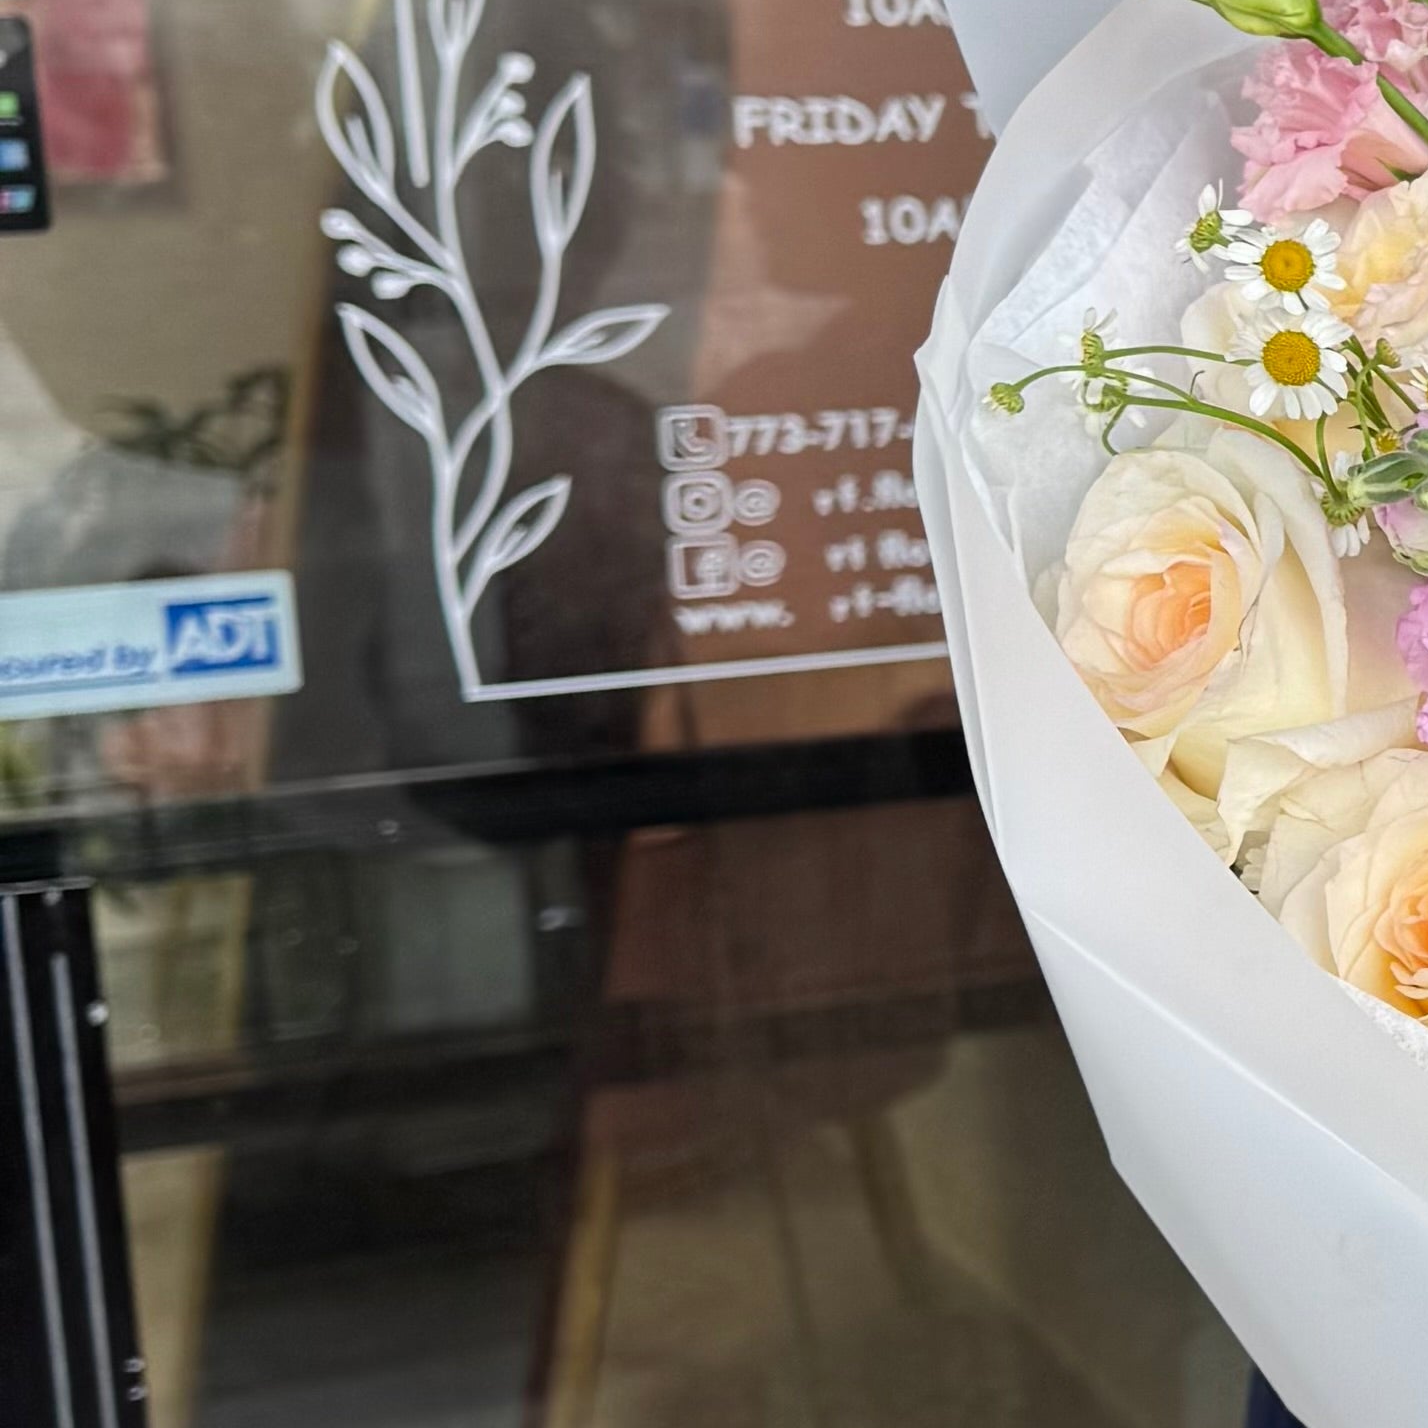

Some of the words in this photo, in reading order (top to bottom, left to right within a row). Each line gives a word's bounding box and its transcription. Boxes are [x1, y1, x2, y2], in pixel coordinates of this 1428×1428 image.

[732, 93, 946, 149] FRIDAY
[860, 193, 974, 246] 10A
[724, 406, 914, 458] 773-717-
[166, 602, 279, 672] ADT
